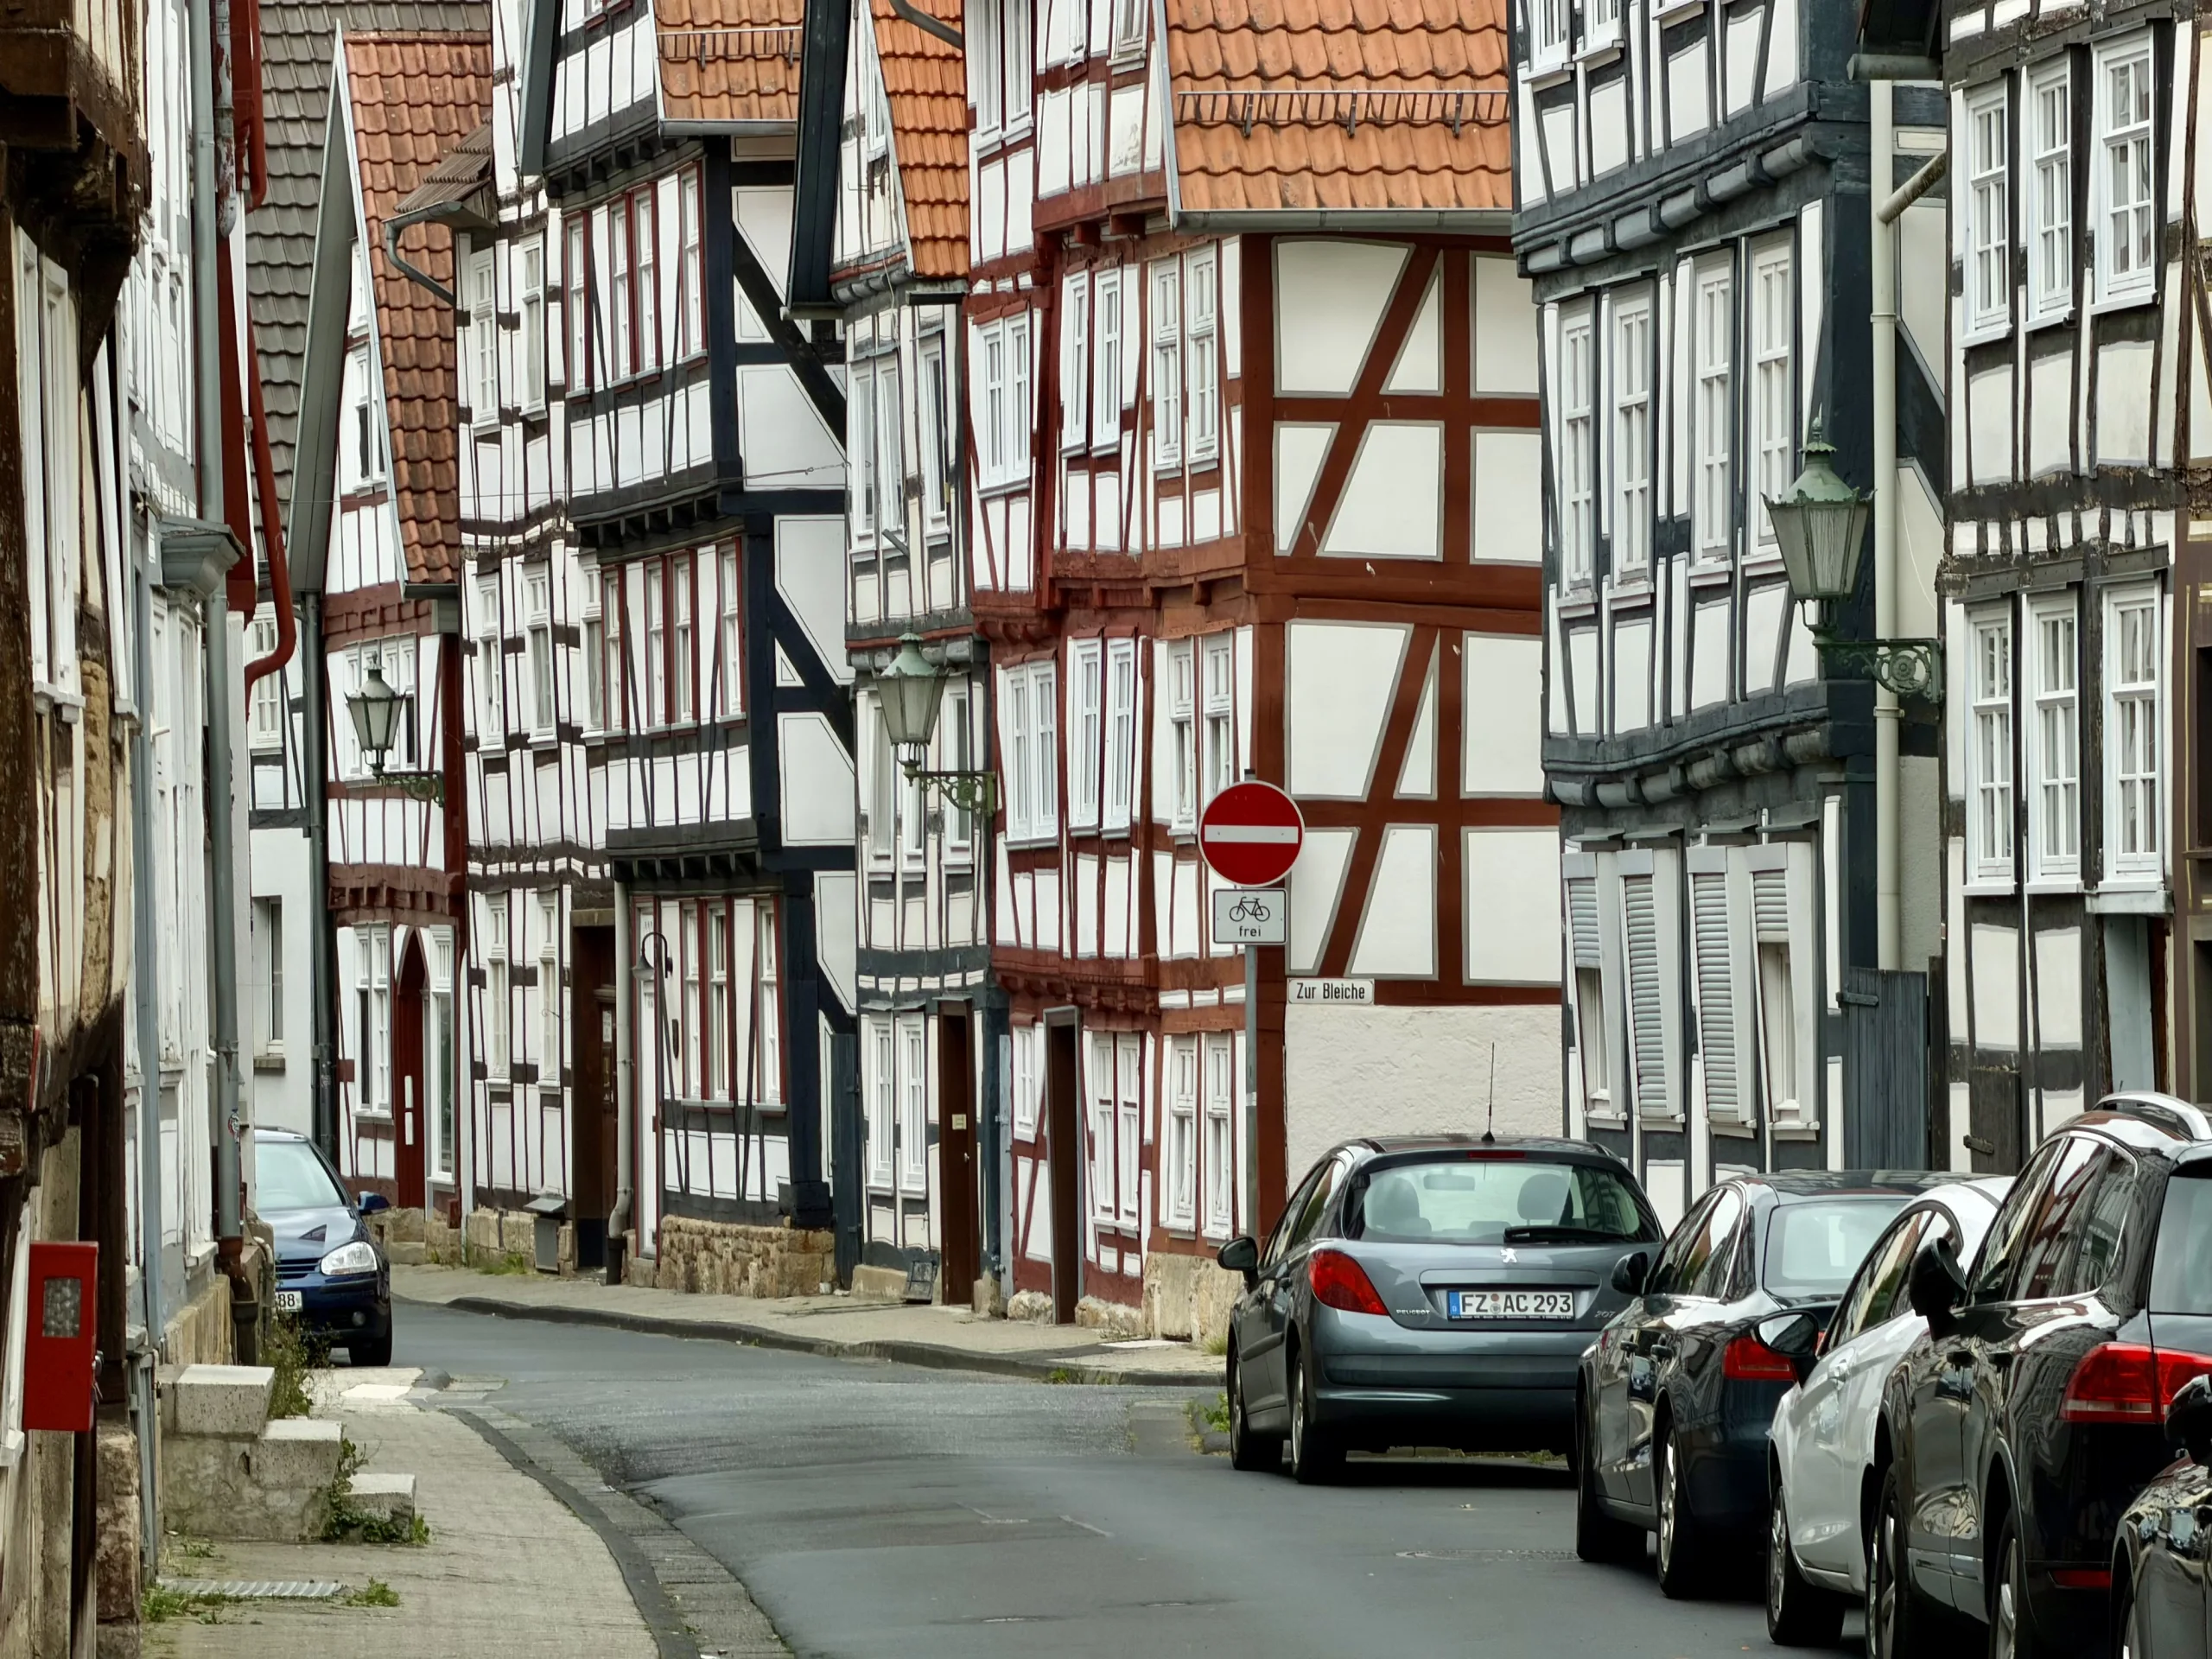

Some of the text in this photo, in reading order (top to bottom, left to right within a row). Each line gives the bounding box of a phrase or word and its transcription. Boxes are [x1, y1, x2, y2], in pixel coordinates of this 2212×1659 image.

[1239, 925, 1261, 937] frei
[1296, 982, 1365, 1000] Zur Bleiche
[1461, 1294, 1488, 1313] FZ
[1503, 1294, 1529, 1313] AC
[1534, 1294, 1571, 1313] 293
